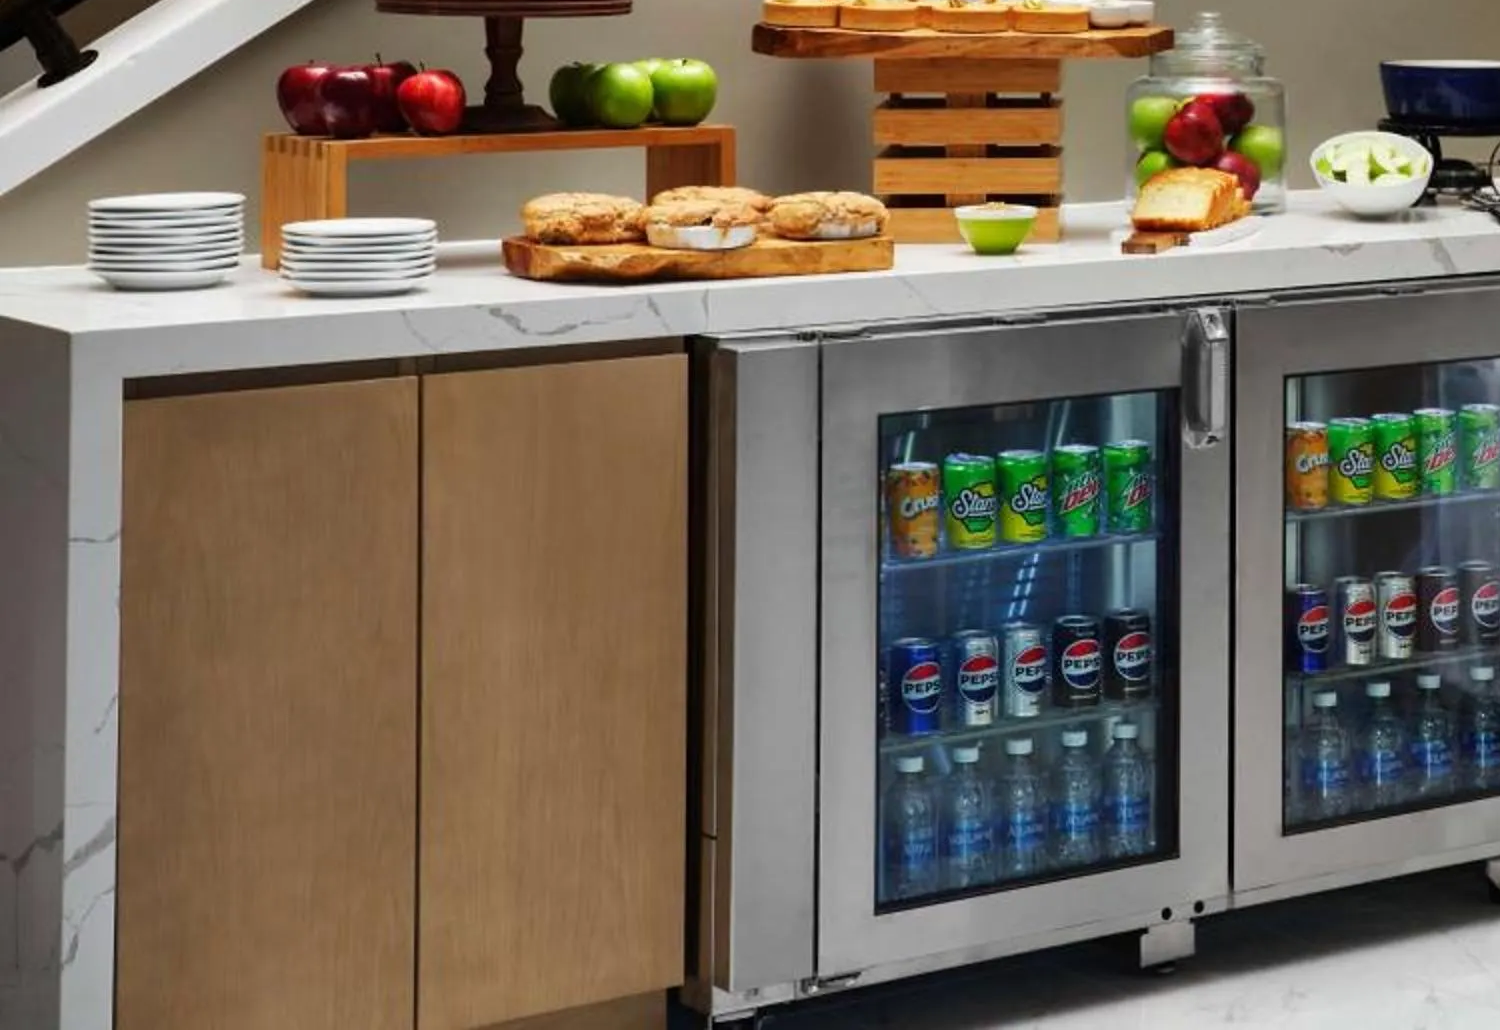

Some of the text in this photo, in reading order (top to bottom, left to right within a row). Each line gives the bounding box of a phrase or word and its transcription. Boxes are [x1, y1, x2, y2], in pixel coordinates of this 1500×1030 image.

[1116, 648, 1149, 662] PEP
[1063, 658, 1100, 669] PEPS
[1015, 666, 1042, 676] PEP
[960, 673, 997, 685] PEPS
[903, 681, 941, 694] PEPS
